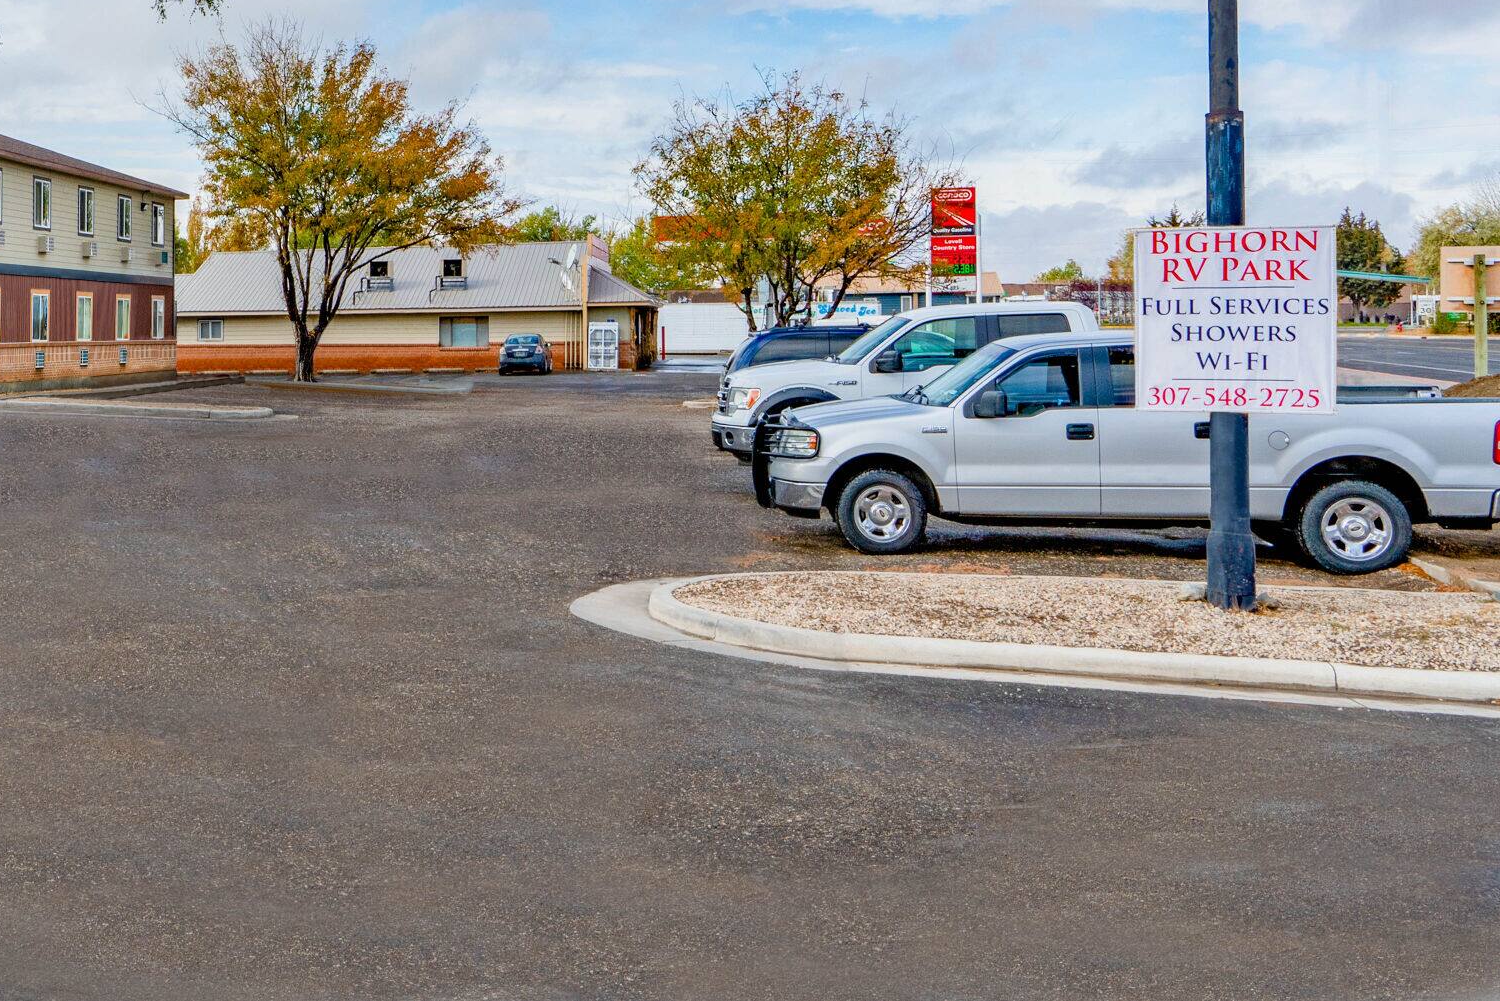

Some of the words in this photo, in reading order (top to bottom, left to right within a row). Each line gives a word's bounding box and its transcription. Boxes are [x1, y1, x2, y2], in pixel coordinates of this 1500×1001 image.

[1150, 230, 1318, 254] BIGHORN
[1161, 258, 1208, 283] RV
[1221, 257, 1311, 282] PARK
[1142, 298, 1201, 316] FULL
[1209, 296, 1330, 315] SERVICES
[1171, 323, 1296, 342] SHOWERS
[1196, 352, 1268, 371] WI-FI
[1148, 387, 1321, 408] 307-548-2725
